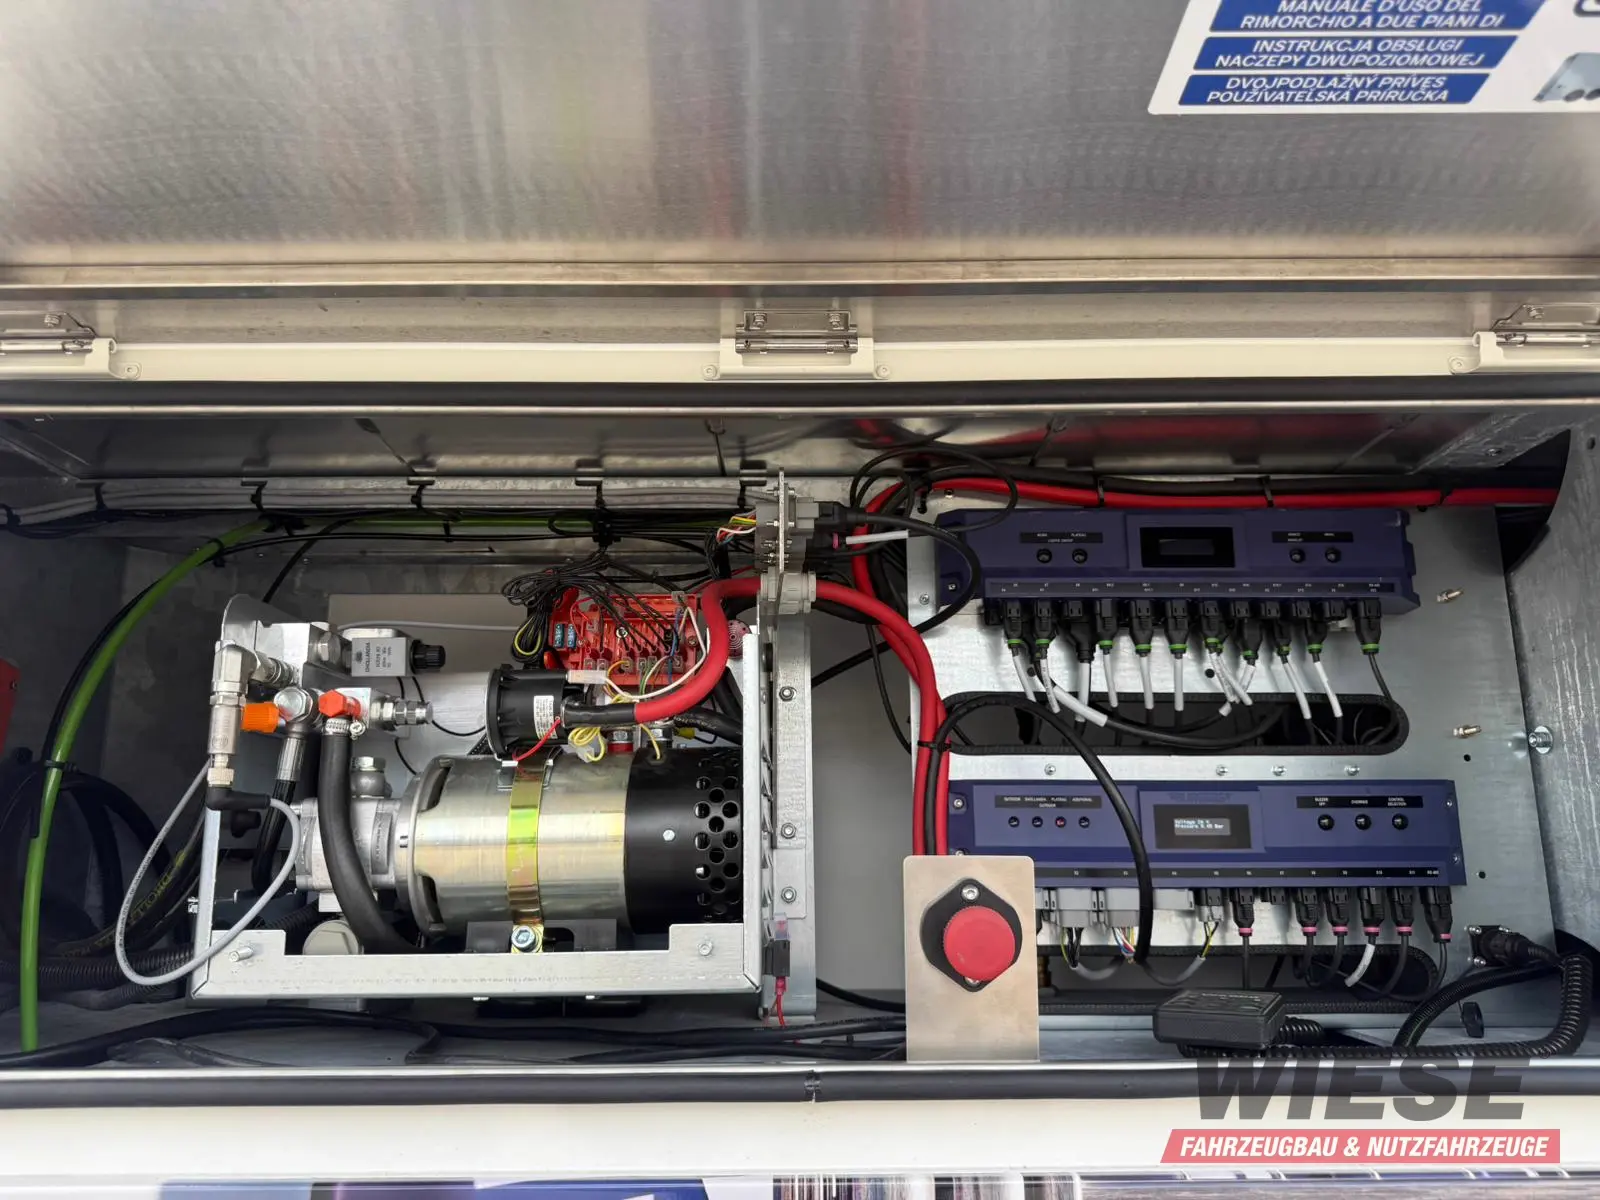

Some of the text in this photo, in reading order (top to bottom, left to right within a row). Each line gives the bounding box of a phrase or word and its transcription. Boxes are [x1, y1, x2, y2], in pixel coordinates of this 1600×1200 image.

[1277, 0, 1481, 13] MANUALE D'USO DEL
[1240, 14, 1506, 29] RIMORCHIO A DUE PIANI DI
[1252, 38, 1465, 53] INSTRUKCJA OBSŁUGI
[1215, 53, 1485, 68] NACZEPY DWUPOZIOMOWEJ
[1226, 74, 1378, 89] DVOJPODLAŽNÝ
